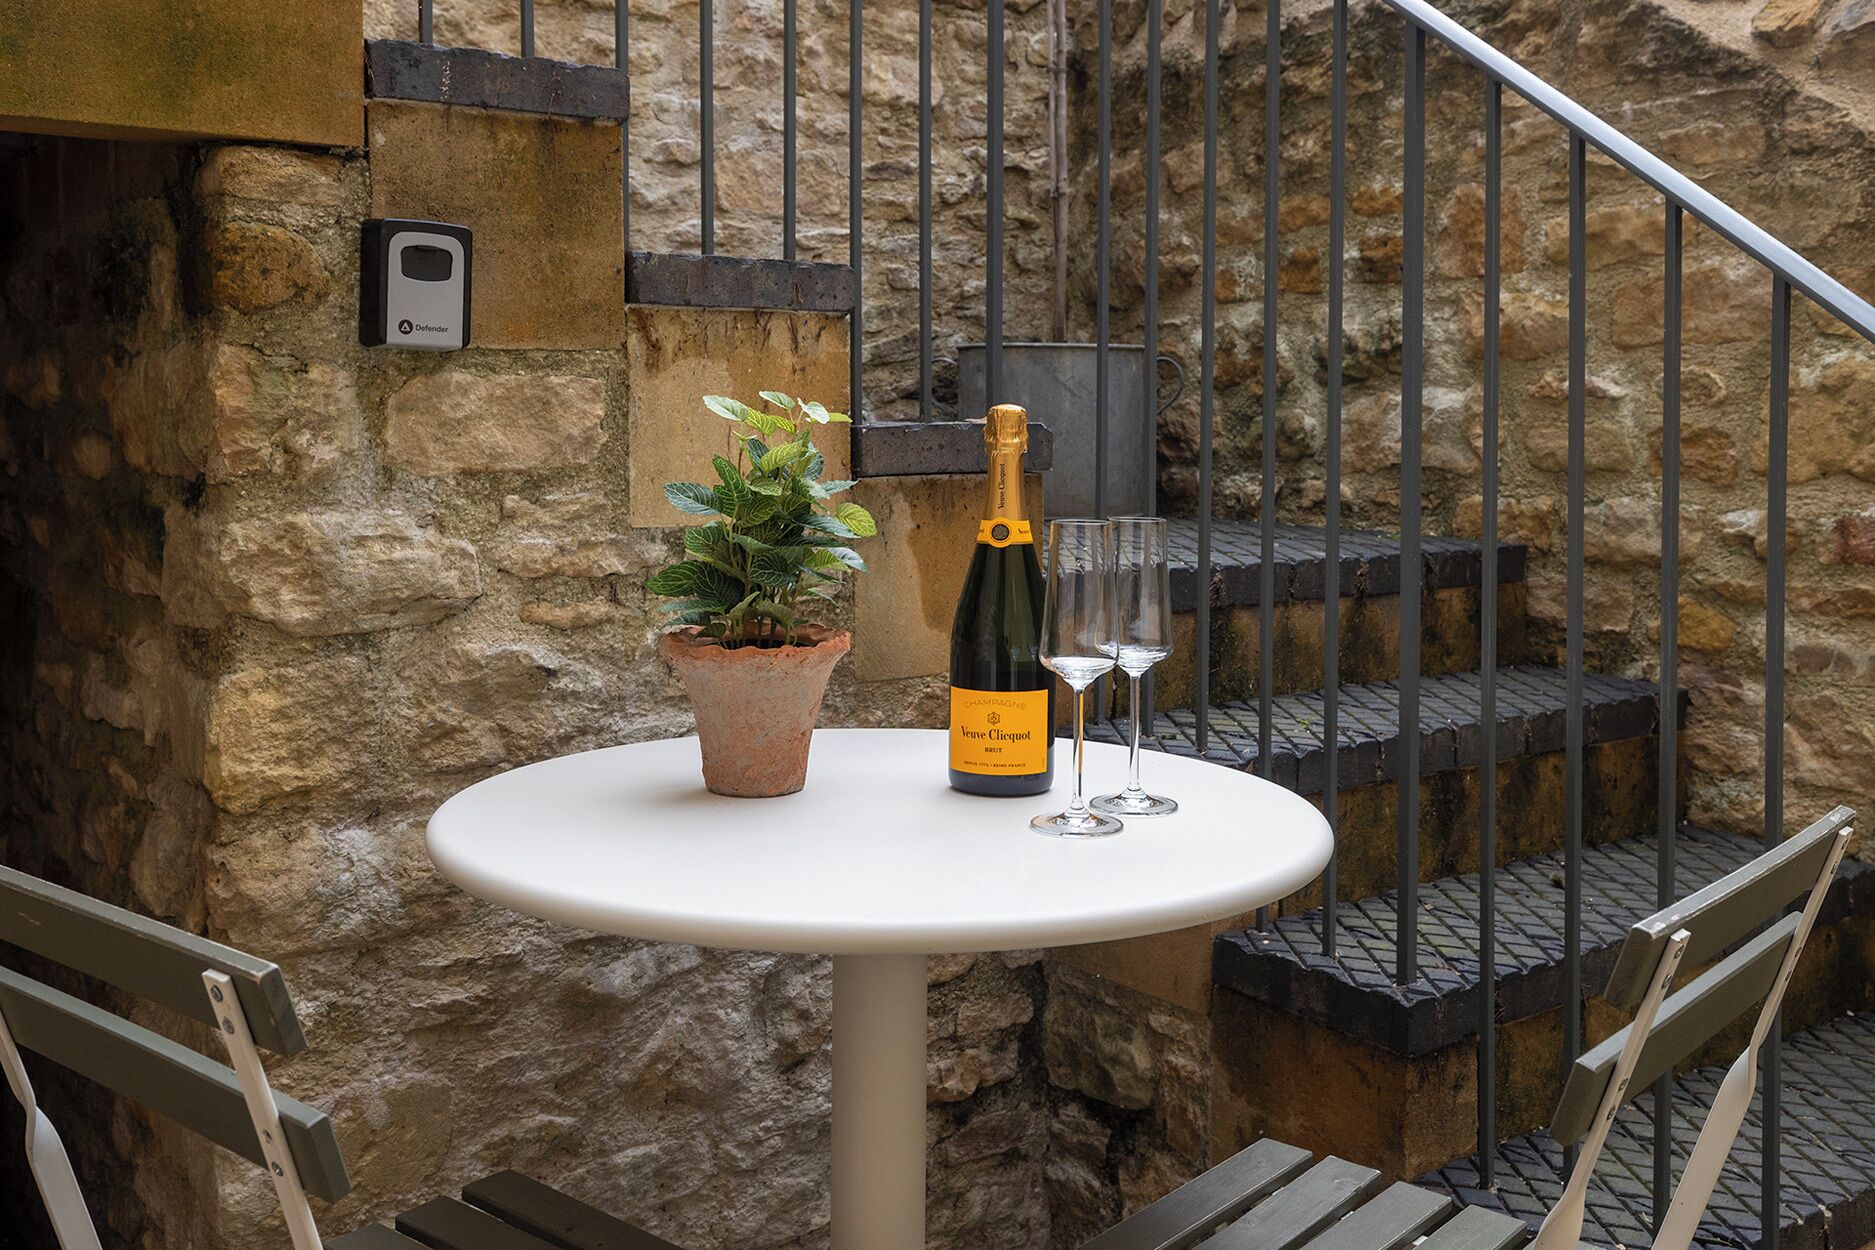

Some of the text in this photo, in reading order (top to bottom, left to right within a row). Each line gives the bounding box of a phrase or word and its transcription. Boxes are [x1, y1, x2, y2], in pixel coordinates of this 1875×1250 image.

[415, 324, 448, 333] Defender
[964, 699, 1027, 711] CHAMPAGNE
[961, 725, 1031, 743] Veuve Clicquot
